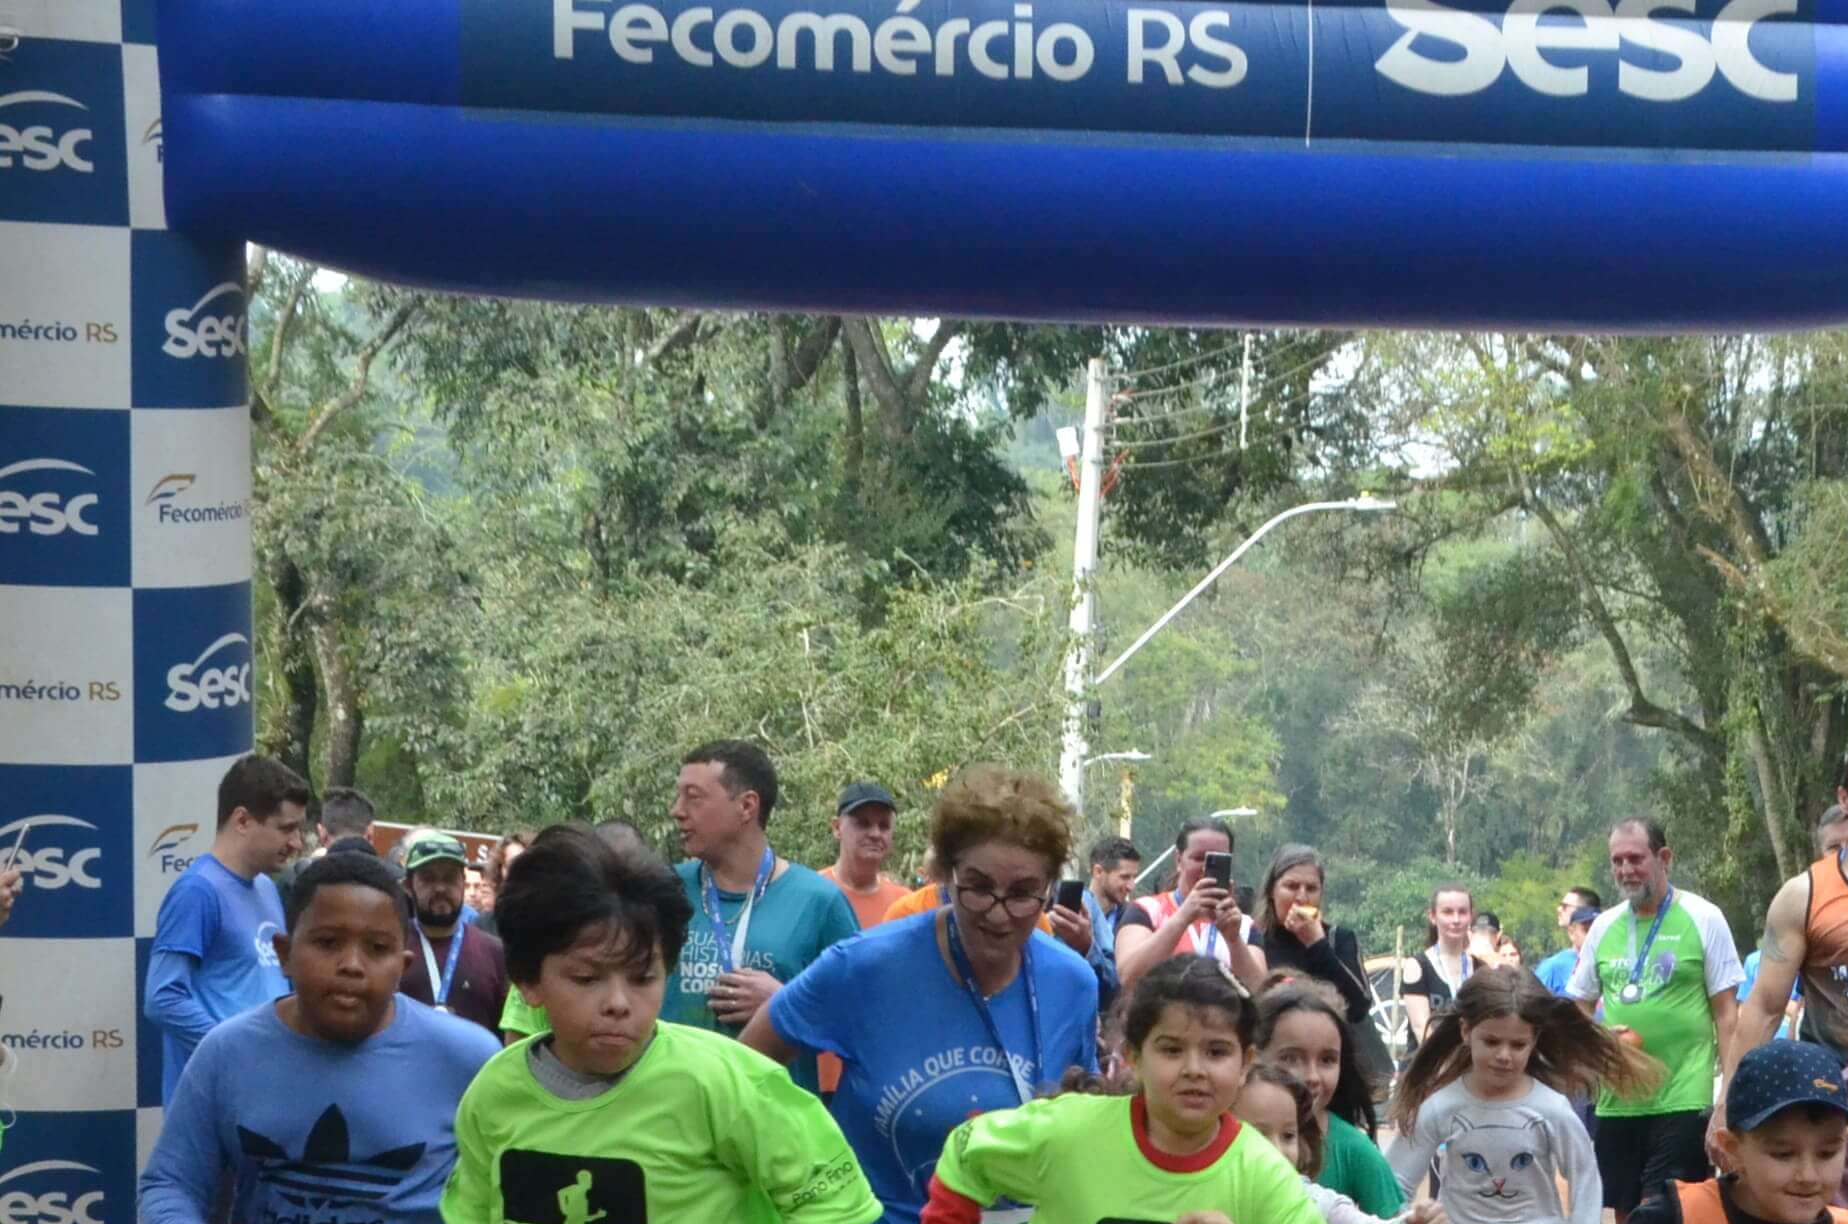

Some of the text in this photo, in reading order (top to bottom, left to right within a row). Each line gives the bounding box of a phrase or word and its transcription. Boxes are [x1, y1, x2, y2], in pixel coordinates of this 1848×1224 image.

[552, 0, 1248, 88] Fecomércio RS
[1374, 0, 1798, 101] Sesc
[0, 123, 94, 173] esc
[0, 319, 118, 343] mércio RS
[0, 491, 98, 536] esc
[0, 681, 120, 701] mércio RS
[0, 847, 101, 889] esc
[1, 1029, 124, 1049] mércio RS
[923, 1047, 965, 1077] QUE
